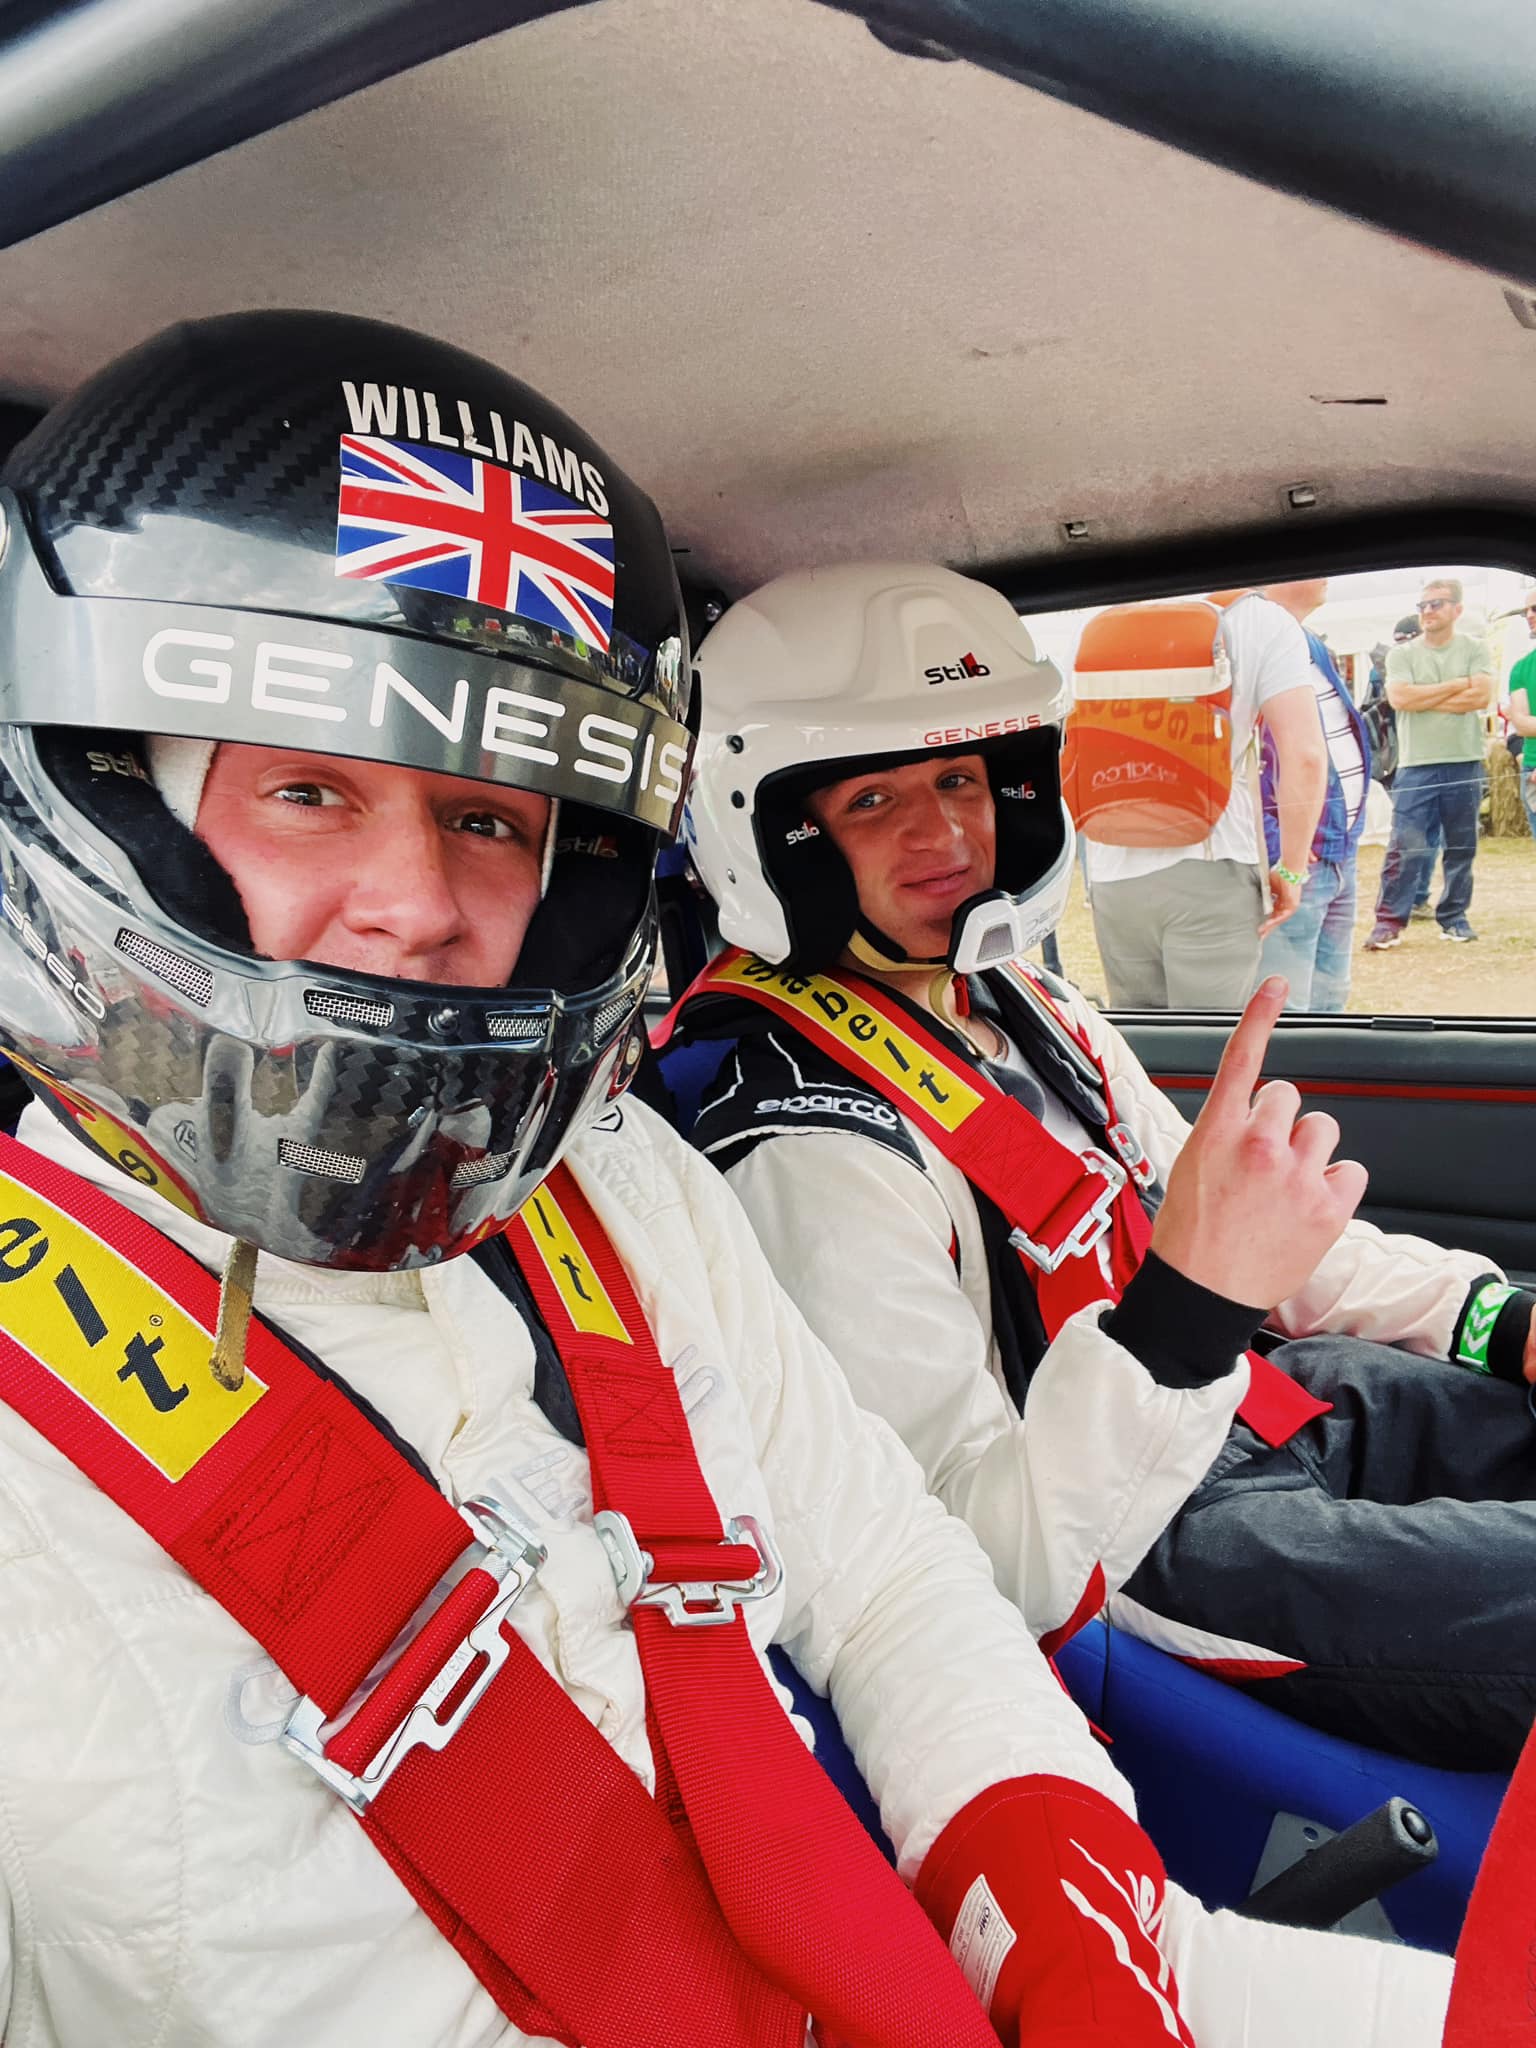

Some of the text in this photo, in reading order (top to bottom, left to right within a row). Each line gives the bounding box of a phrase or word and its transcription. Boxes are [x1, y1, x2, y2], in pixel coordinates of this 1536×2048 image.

[341, 381, 610, 518] WILLIAMS
[924, 653, 990, 685] Stilo
[142, 628, 689, 804] GENESIS
[924, 714, 1042, 746] GENESIS
[1001, 783, 1036, 800] Stilo
[786, 820, 820, 845] Stilo
[753, 1094, 899, 1130] sparco
